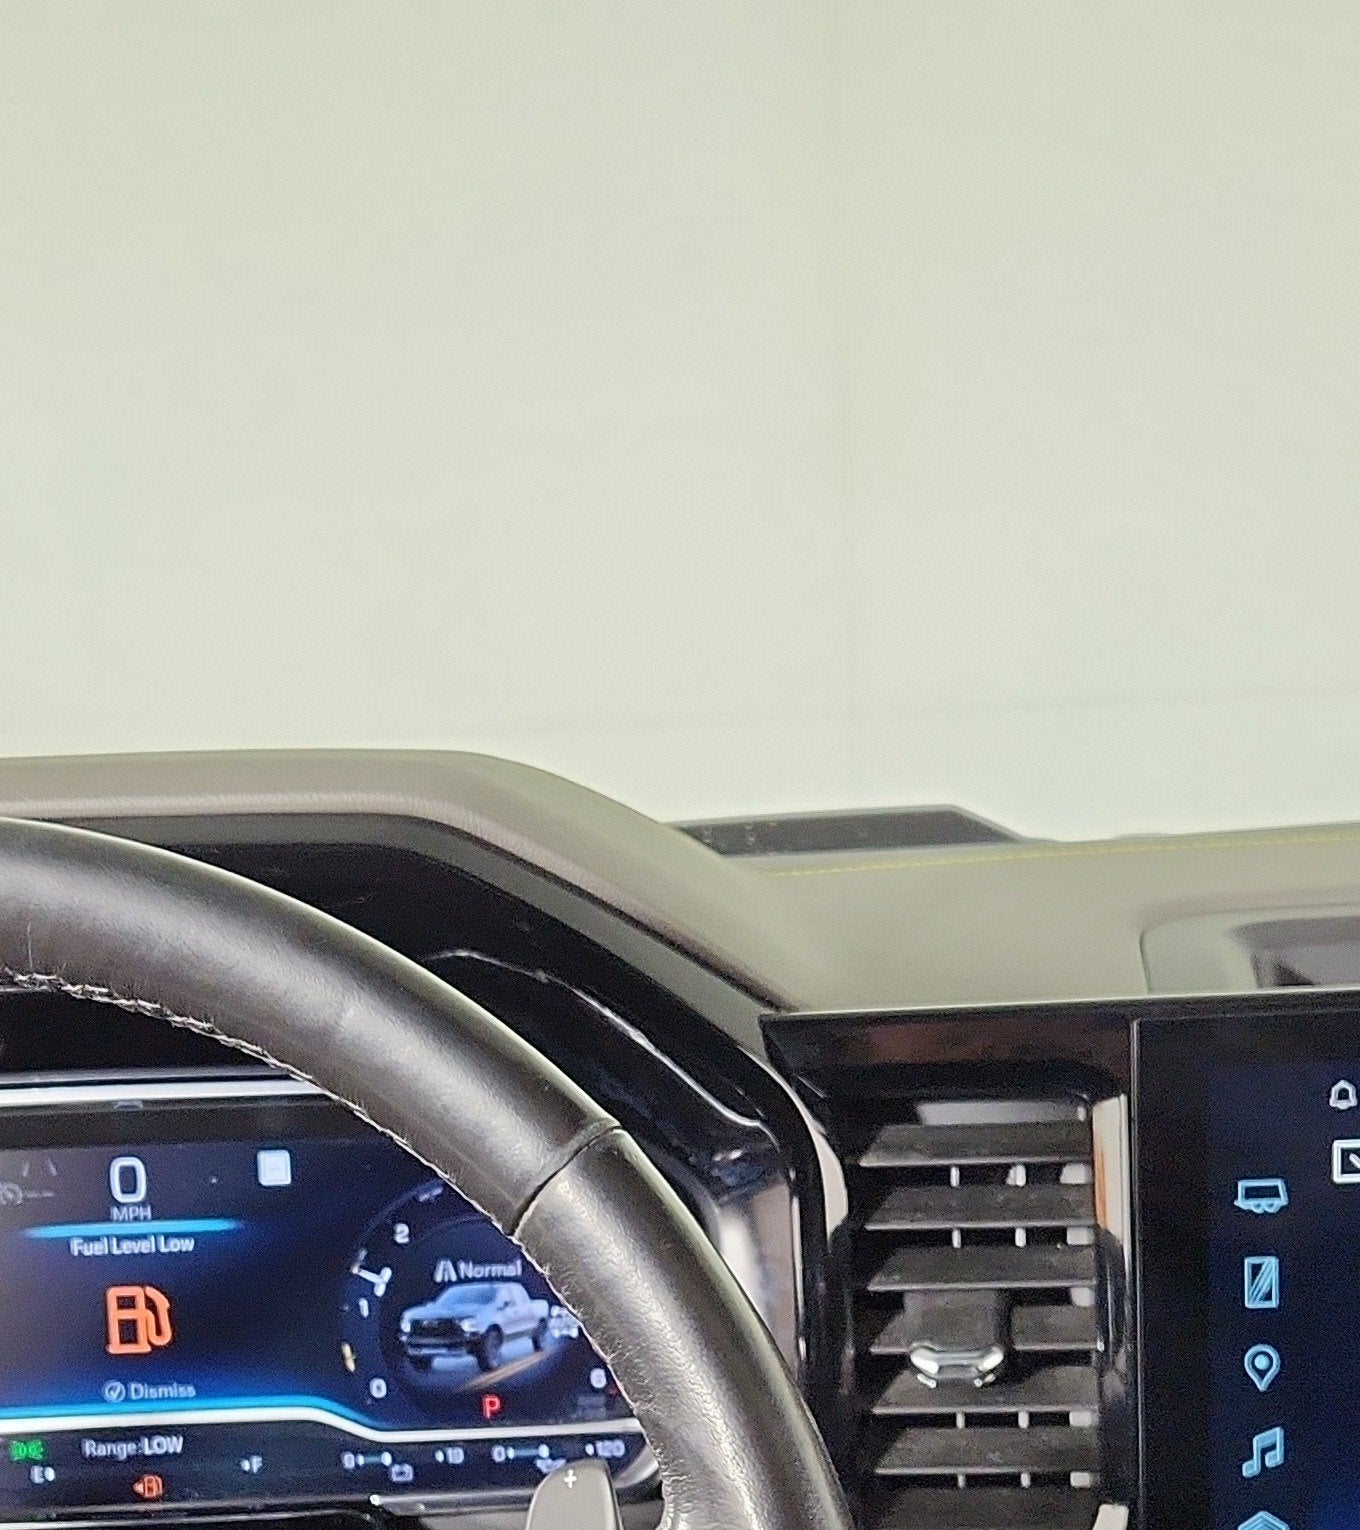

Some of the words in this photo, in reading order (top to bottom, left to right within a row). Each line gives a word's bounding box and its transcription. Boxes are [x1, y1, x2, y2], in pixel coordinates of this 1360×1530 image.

[110, 1156, 147, 1203] 0
[111, 1205, 152, 1221] MPH
[393, 1222, 410, 1245] 2
[70, 1237, 109, 1256] Fuel
[110, 1235, 155, 1255] Level
[157, 1234, 195, 1252] Low
[458, 1260, 523, 1279] Normal
[358, 1297, 369, 1318] 1
[128, 1381, 197, 1400] Dismiss
[369, 1377, 387, 1399] 0
[482, 1393, 502, 1419] P
[143, 1435, 184, 1456] LOW
[249, 1455, 262, 1473] F
